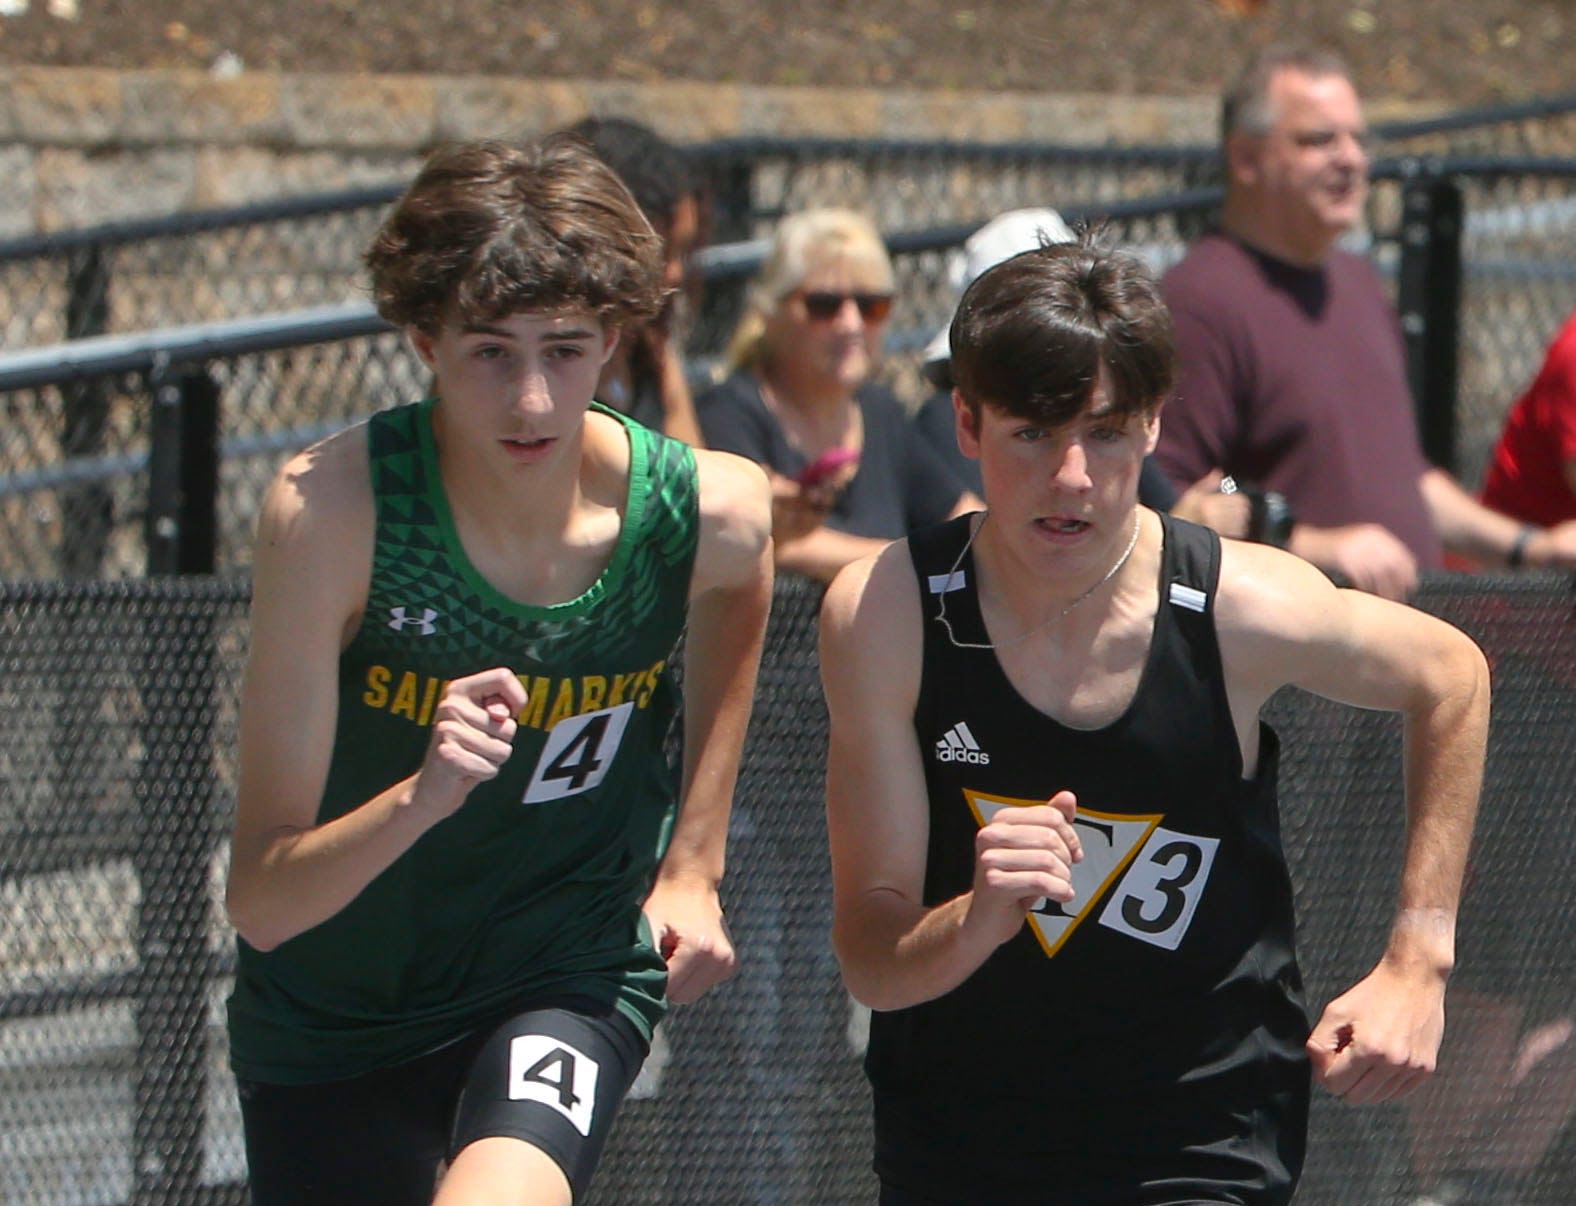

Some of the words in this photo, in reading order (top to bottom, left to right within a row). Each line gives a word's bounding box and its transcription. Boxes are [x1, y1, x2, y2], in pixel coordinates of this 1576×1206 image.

[362, 664, 450, 727] SAI
[541, 714, 612, 790] 4
[1121, 841, 1203, 934] 3
[523, 1047, 581, 1112] 4
